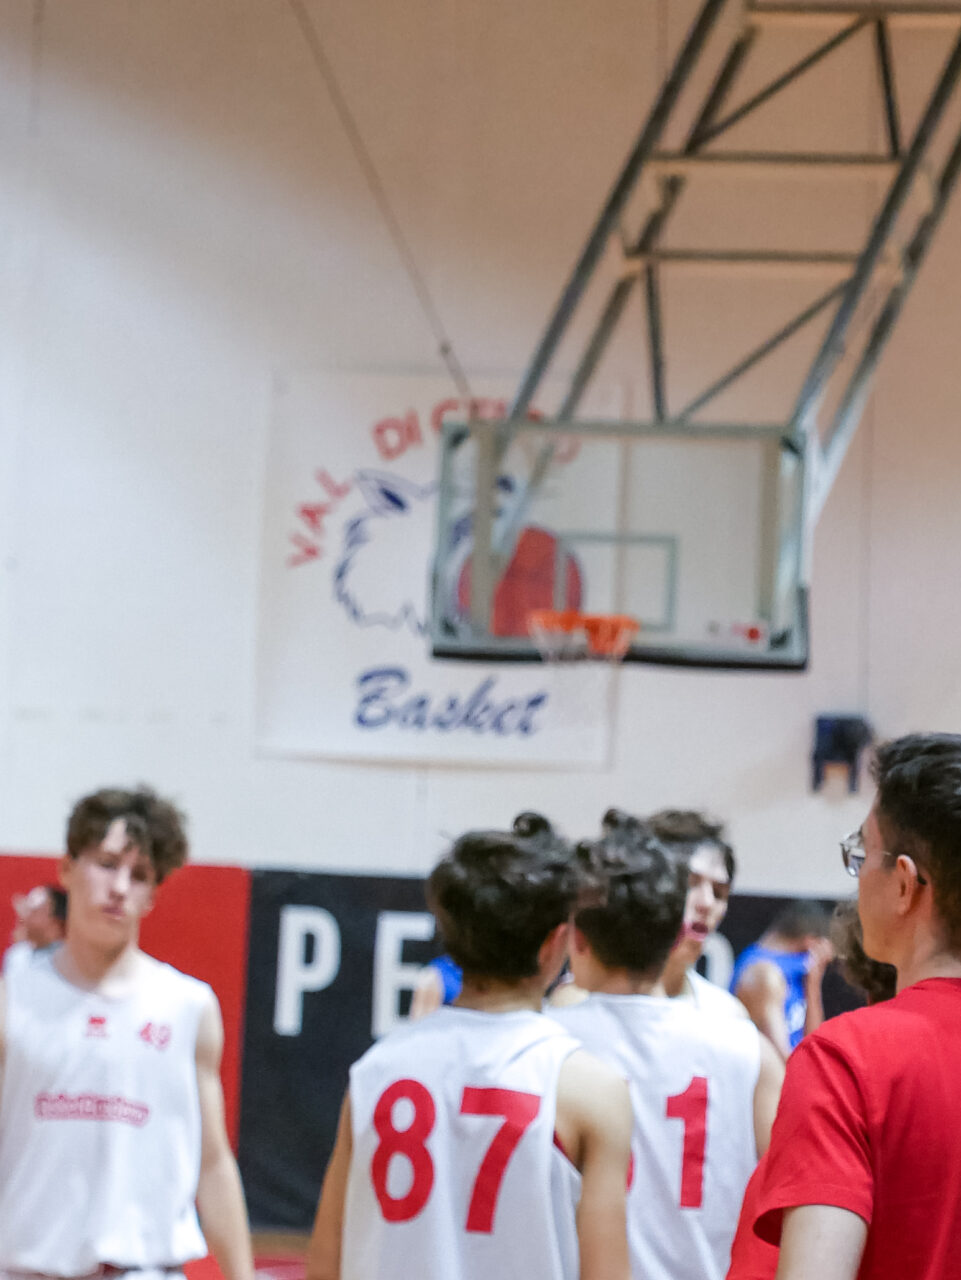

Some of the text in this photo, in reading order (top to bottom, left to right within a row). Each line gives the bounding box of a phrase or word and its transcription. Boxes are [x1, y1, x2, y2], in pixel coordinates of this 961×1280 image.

[286, 409, 422, 569] VAL DI
[355, 667, 548, 738] Basket
[370, 1079, 541, 1234] 87
